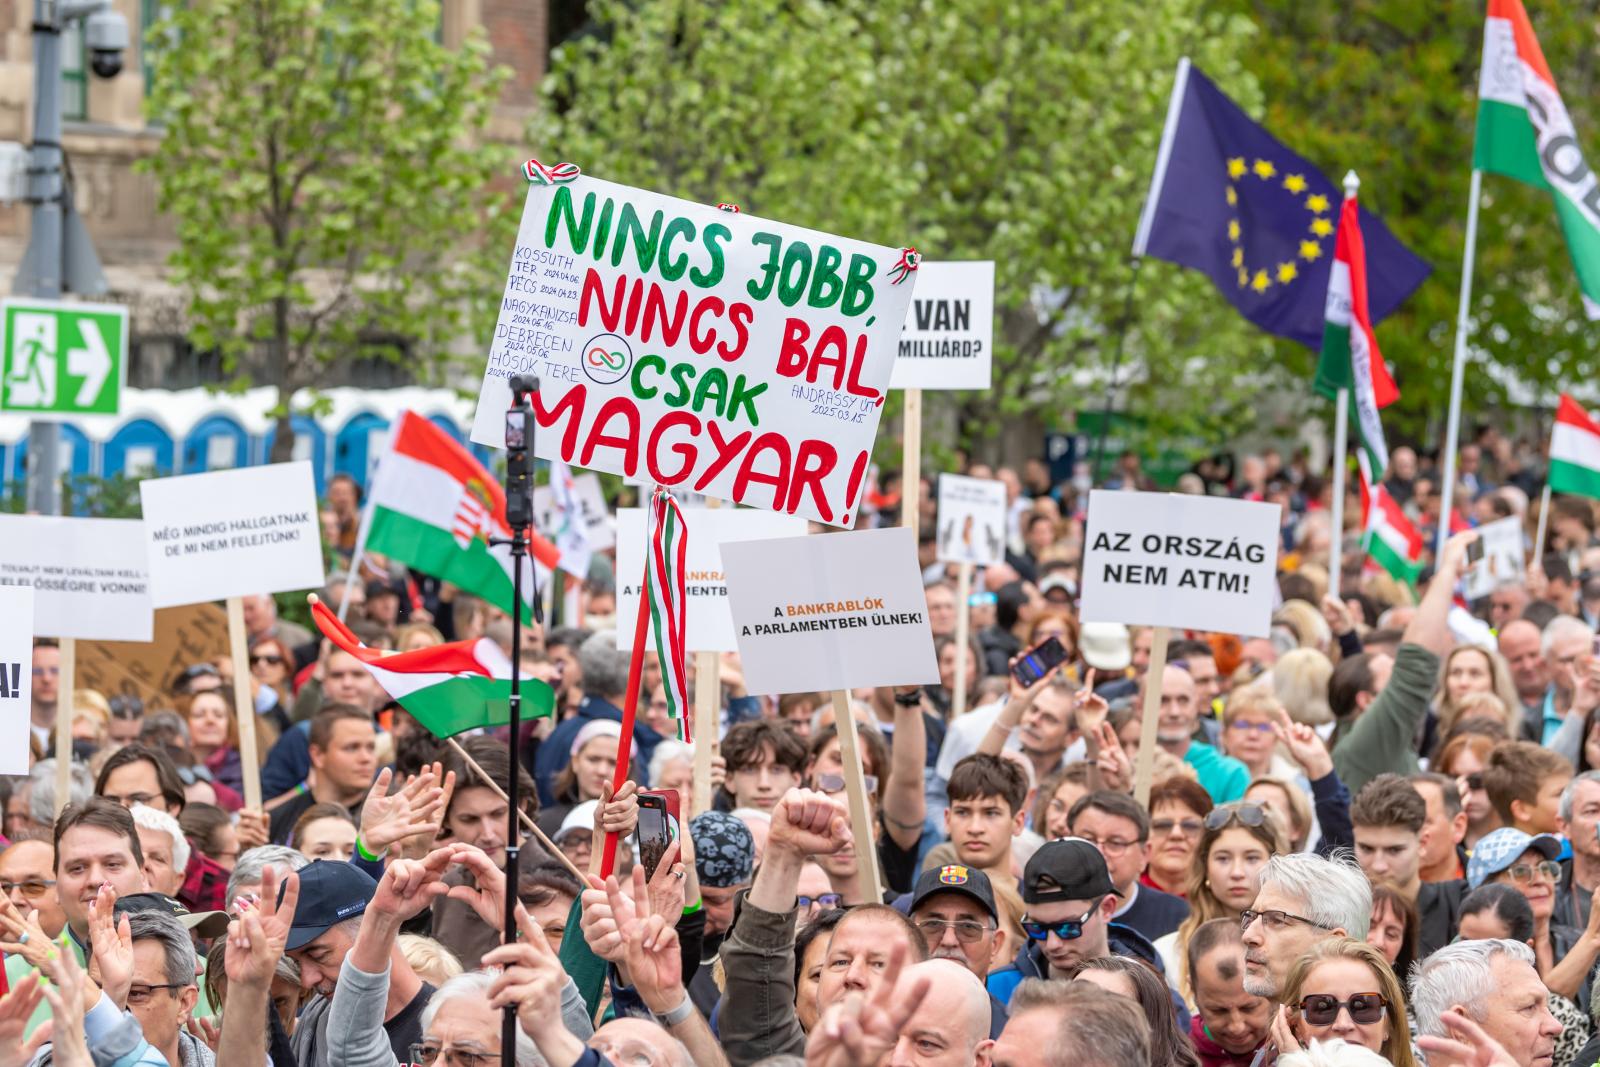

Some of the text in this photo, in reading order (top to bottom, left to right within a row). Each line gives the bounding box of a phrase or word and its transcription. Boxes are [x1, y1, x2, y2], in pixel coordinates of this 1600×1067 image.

[515, 245, 574, 270] KOSSUTH
[515, 260, 538, 276] TÉR
[545, 186, 877, 327] NINCS JOBB,
[509, 275, 538, 294] PÉCS
[503, 297, 578, 325] NAGYKANIZSA
[914, 299, 970, 331] VAN
[497, 323, 574, 352] DEBRECEN
[578, 268, 884, 407] NINCS BAL,
[898, 337, 982, 358] MILLIÁRD?
[544, 361, 582, 383] TERE
[630, 354, 768, 426] CSAK
[791, 384, 858, 409] ANDRÁSSY
[152, 512, 310, 542] MÉG MINDIG HALLGATNAK
[164, 546, 181, 557] DE
[200, 540, 228, 552] NEM
[231, 529, 301, 549] FELEJTÜNK!
[1092, 532, 1266, 564] AZ ORSZÁG
[1103, 563, 1250, 594] NEM ATM!
[773, 597, 885, 618] A BANKRABLÓK
[741, 611, 923, 637] A PARLAMENTBEN ÜLNEK!
